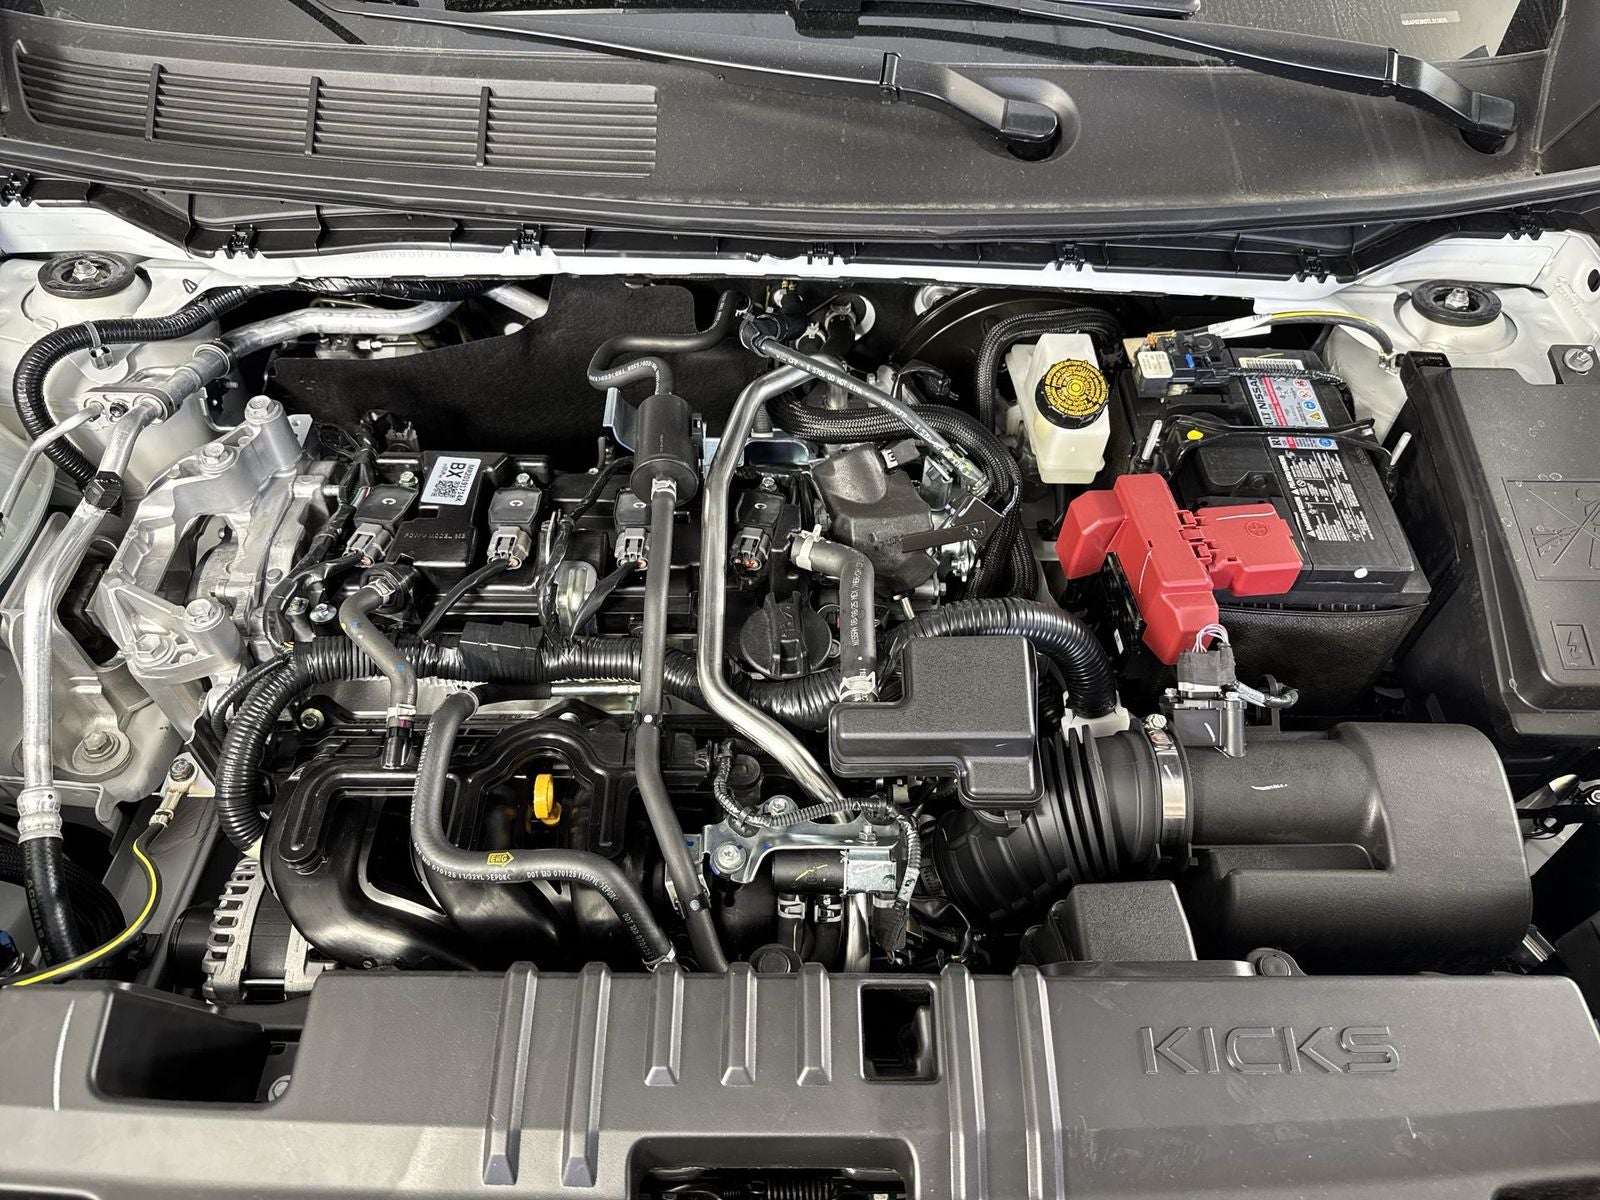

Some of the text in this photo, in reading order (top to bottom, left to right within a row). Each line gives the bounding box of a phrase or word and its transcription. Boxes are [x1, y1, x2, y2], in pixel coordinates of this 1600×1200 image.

[446, 462, 466, 478] BX
[850, 590, 859, 601] MEX
[850, 626, 860, 647] NISSAN
[491, 854, 508, 863] ENG
[431, 864, 457, 879] 070125
[526, 870, 540, 879] DOT
[553, 870, 577, 879] 070125
[622, 912, 634, 926] DOT
[1140, 1025, 1400, 1075] KICKS
